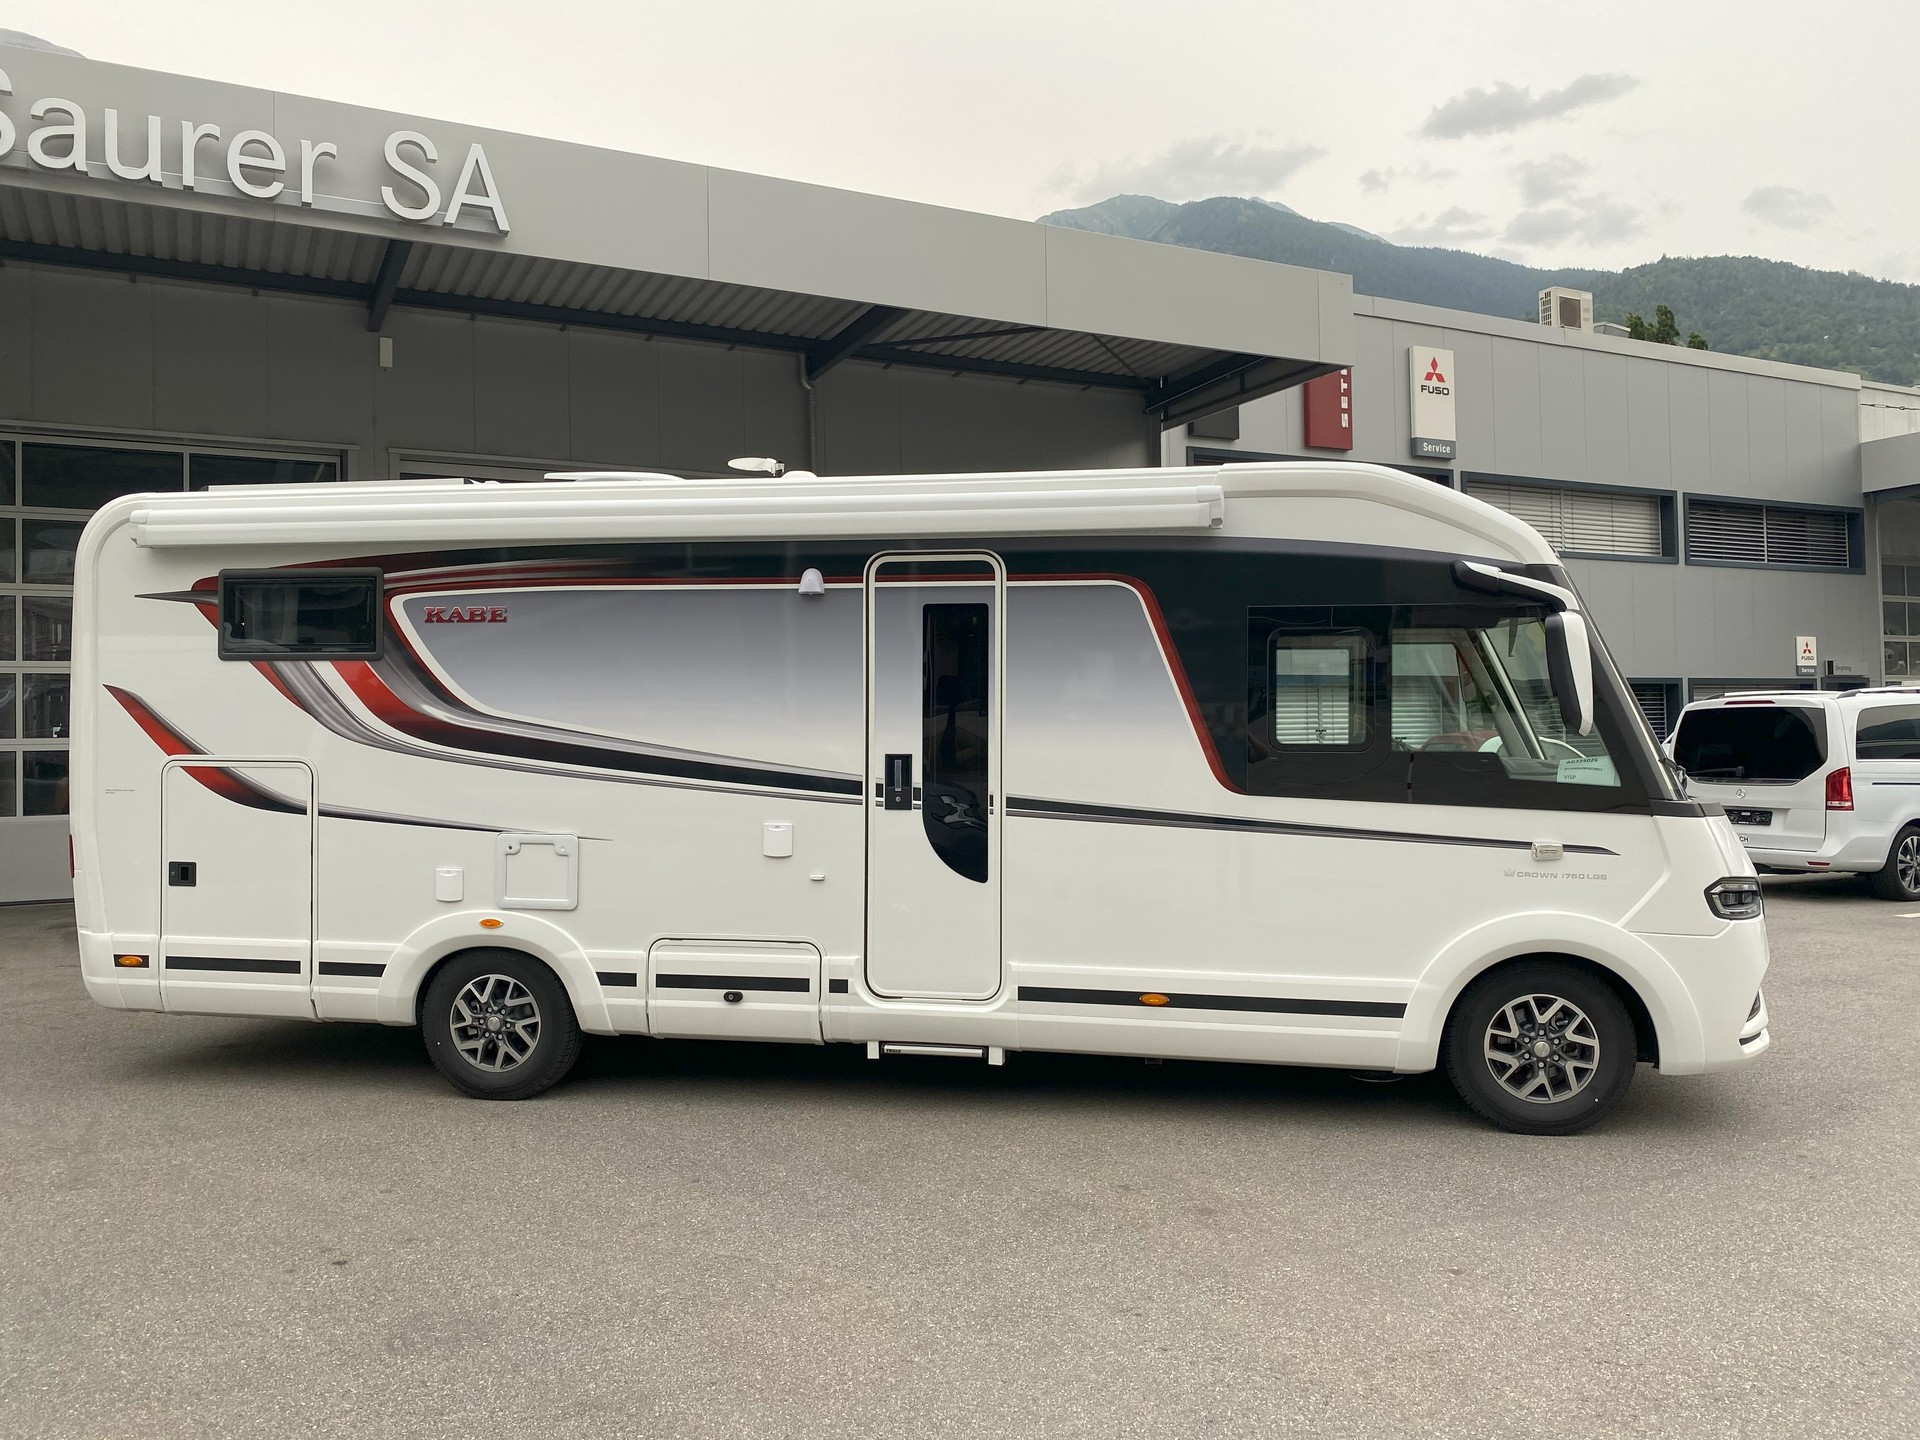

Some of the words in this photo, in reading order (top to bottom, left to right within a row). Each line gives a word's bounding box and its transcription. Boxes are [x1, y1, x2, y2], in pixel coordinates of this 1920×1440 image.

[0, 67, 338, 207] aurer
[380, 130, 510, 237] SA
[1420, 384, 1450, 396] FUSO
[1423, 442, 1451, 454] Service
[424, 606, 508, 623] KABE
[1516, 871, 1558, 879] CROWN
